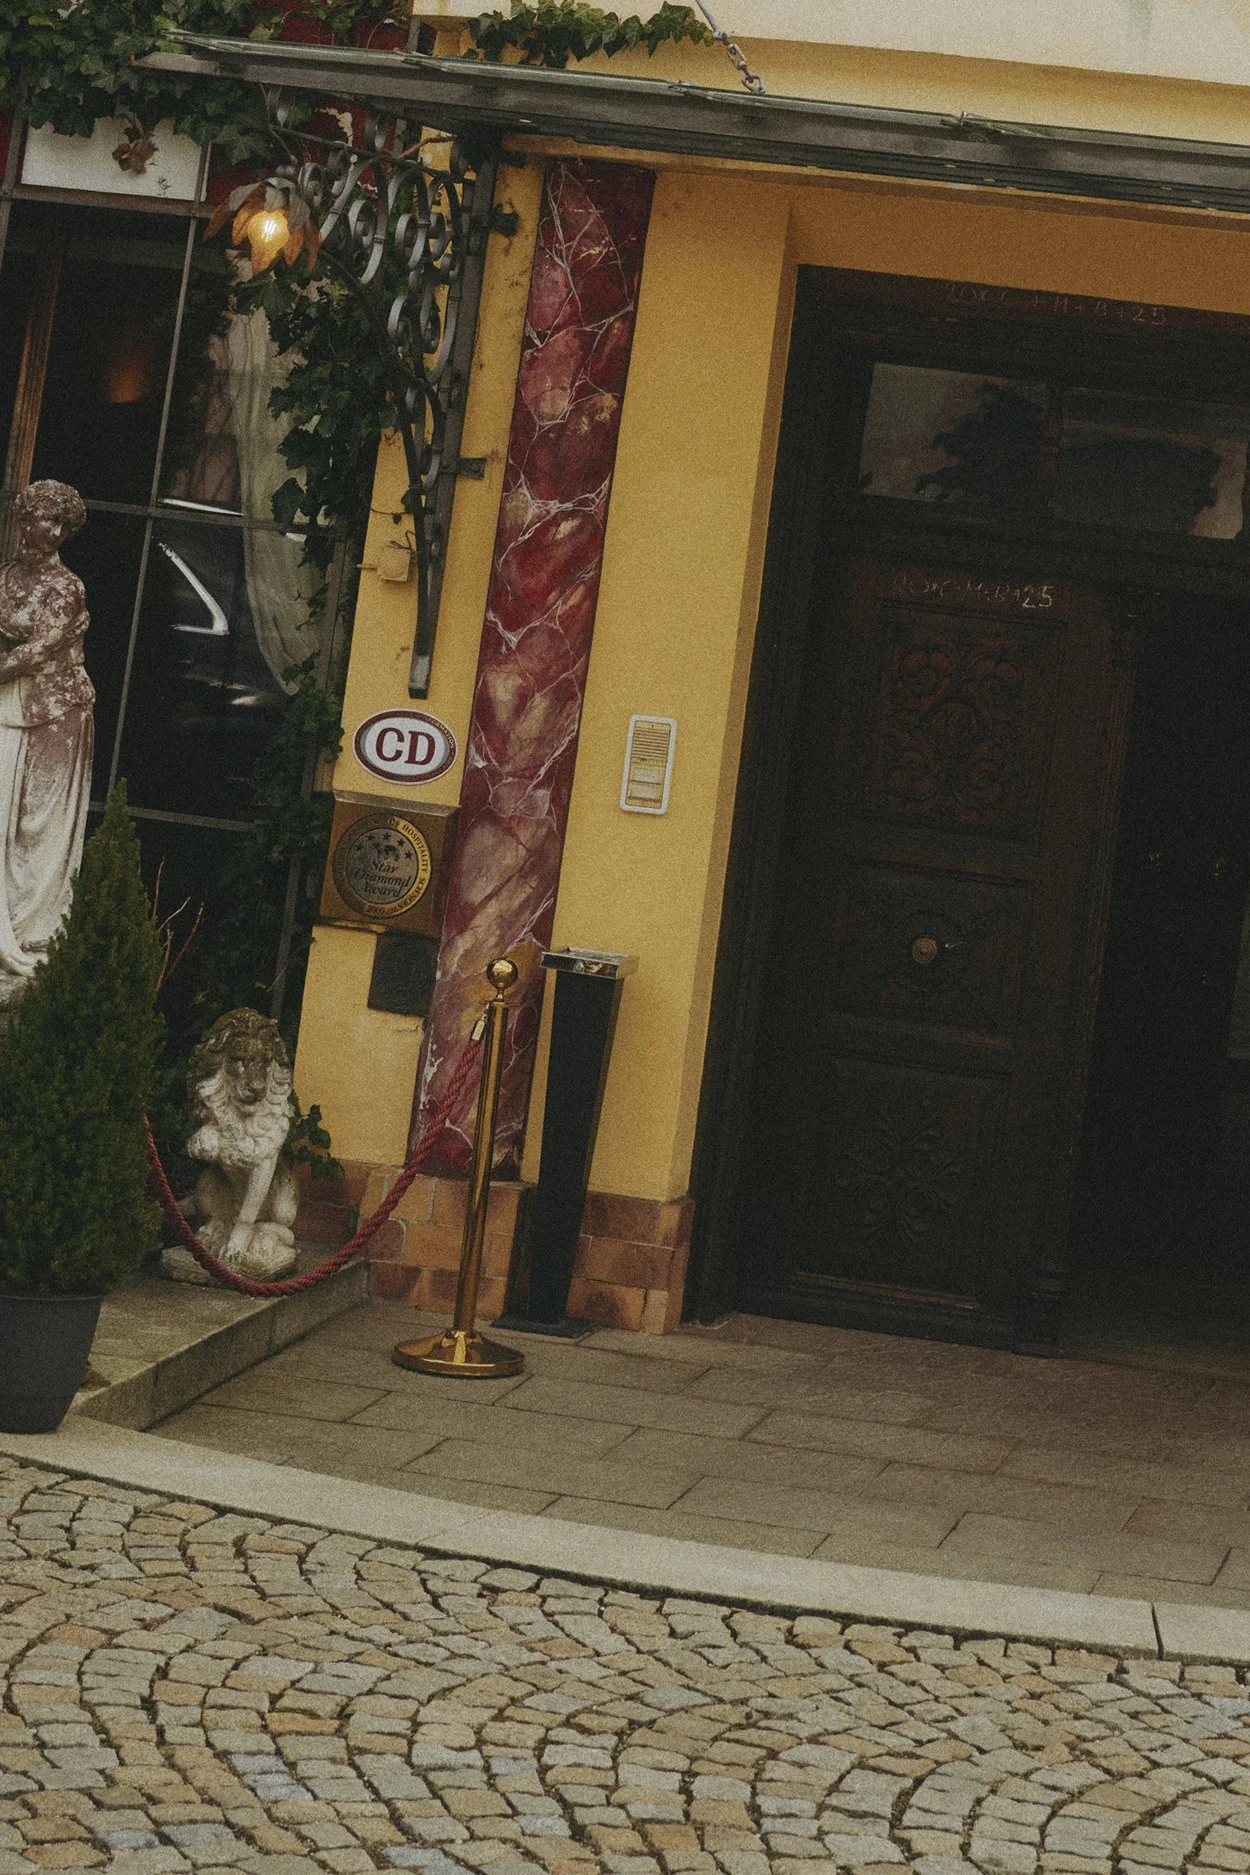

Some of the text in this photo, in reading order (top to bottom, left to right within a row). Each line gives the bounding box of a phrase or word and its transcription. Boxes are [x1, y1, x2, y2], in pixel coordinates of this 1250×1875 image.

[375, 727, 436, 766] CD
[402, 824, 429, 874] HOSPITALITY
[353, 867, 412, 888] Diamond
[369, 859, 399, 874] Star
